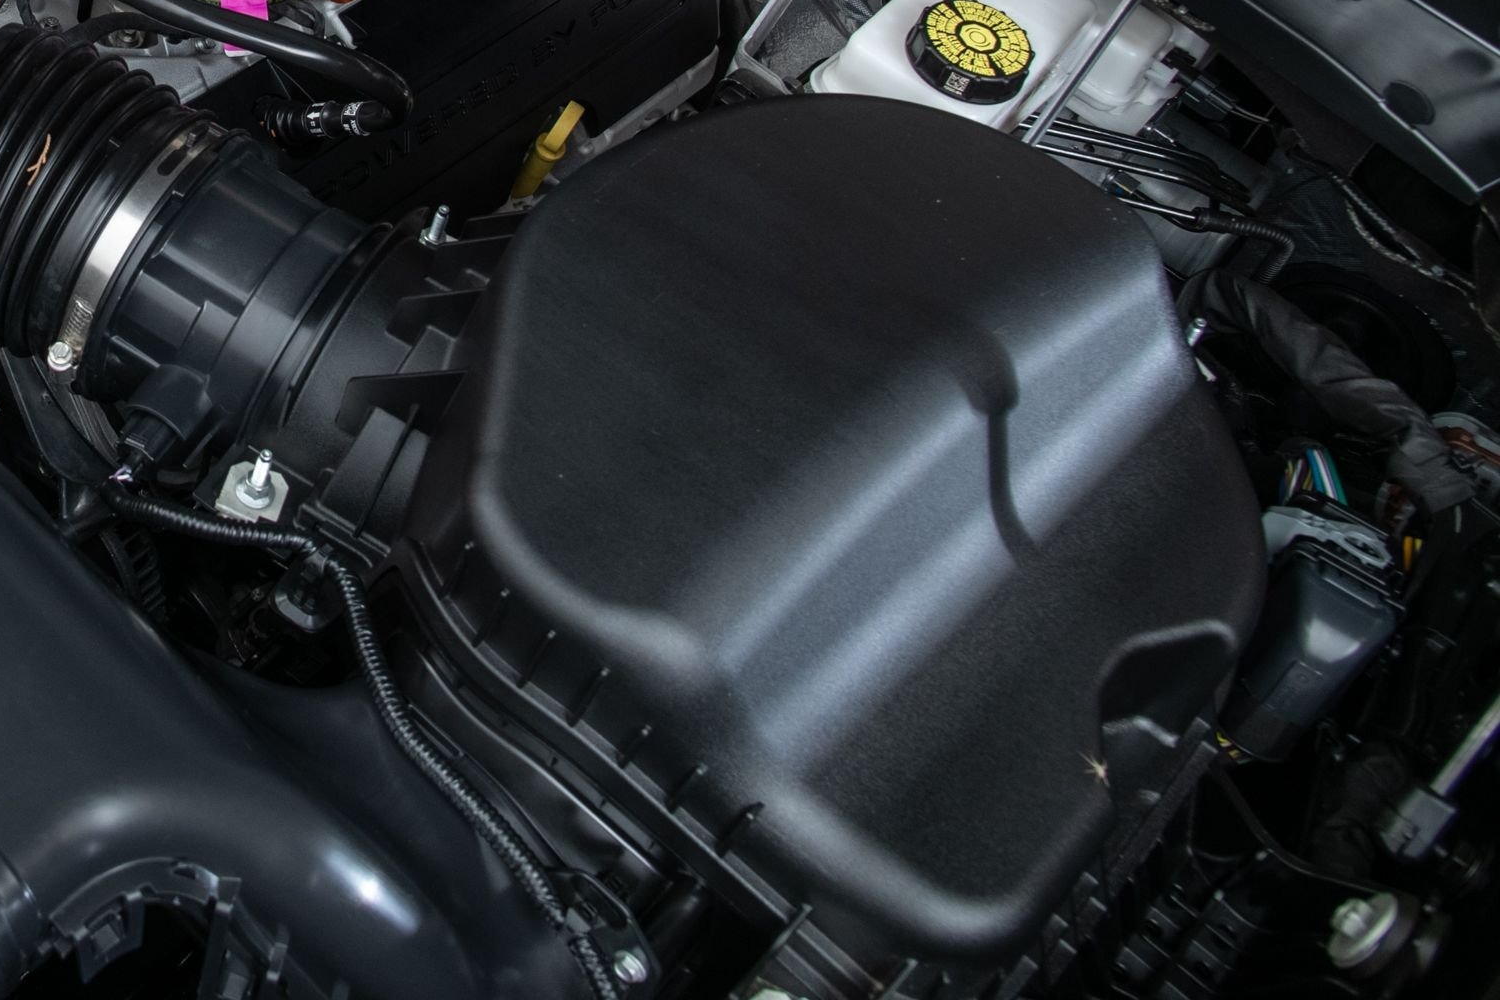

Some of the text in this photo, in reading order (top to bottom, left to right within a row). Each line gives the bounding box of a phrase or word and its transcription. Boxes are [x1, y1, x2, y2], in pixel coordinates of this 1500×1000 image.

[320, 62, 519, 201] POWERED
[531, 18, 576, 68] BY
[936, 45, 960, 64] SEALED
[958, 60, 997, 75] CONTAINER
